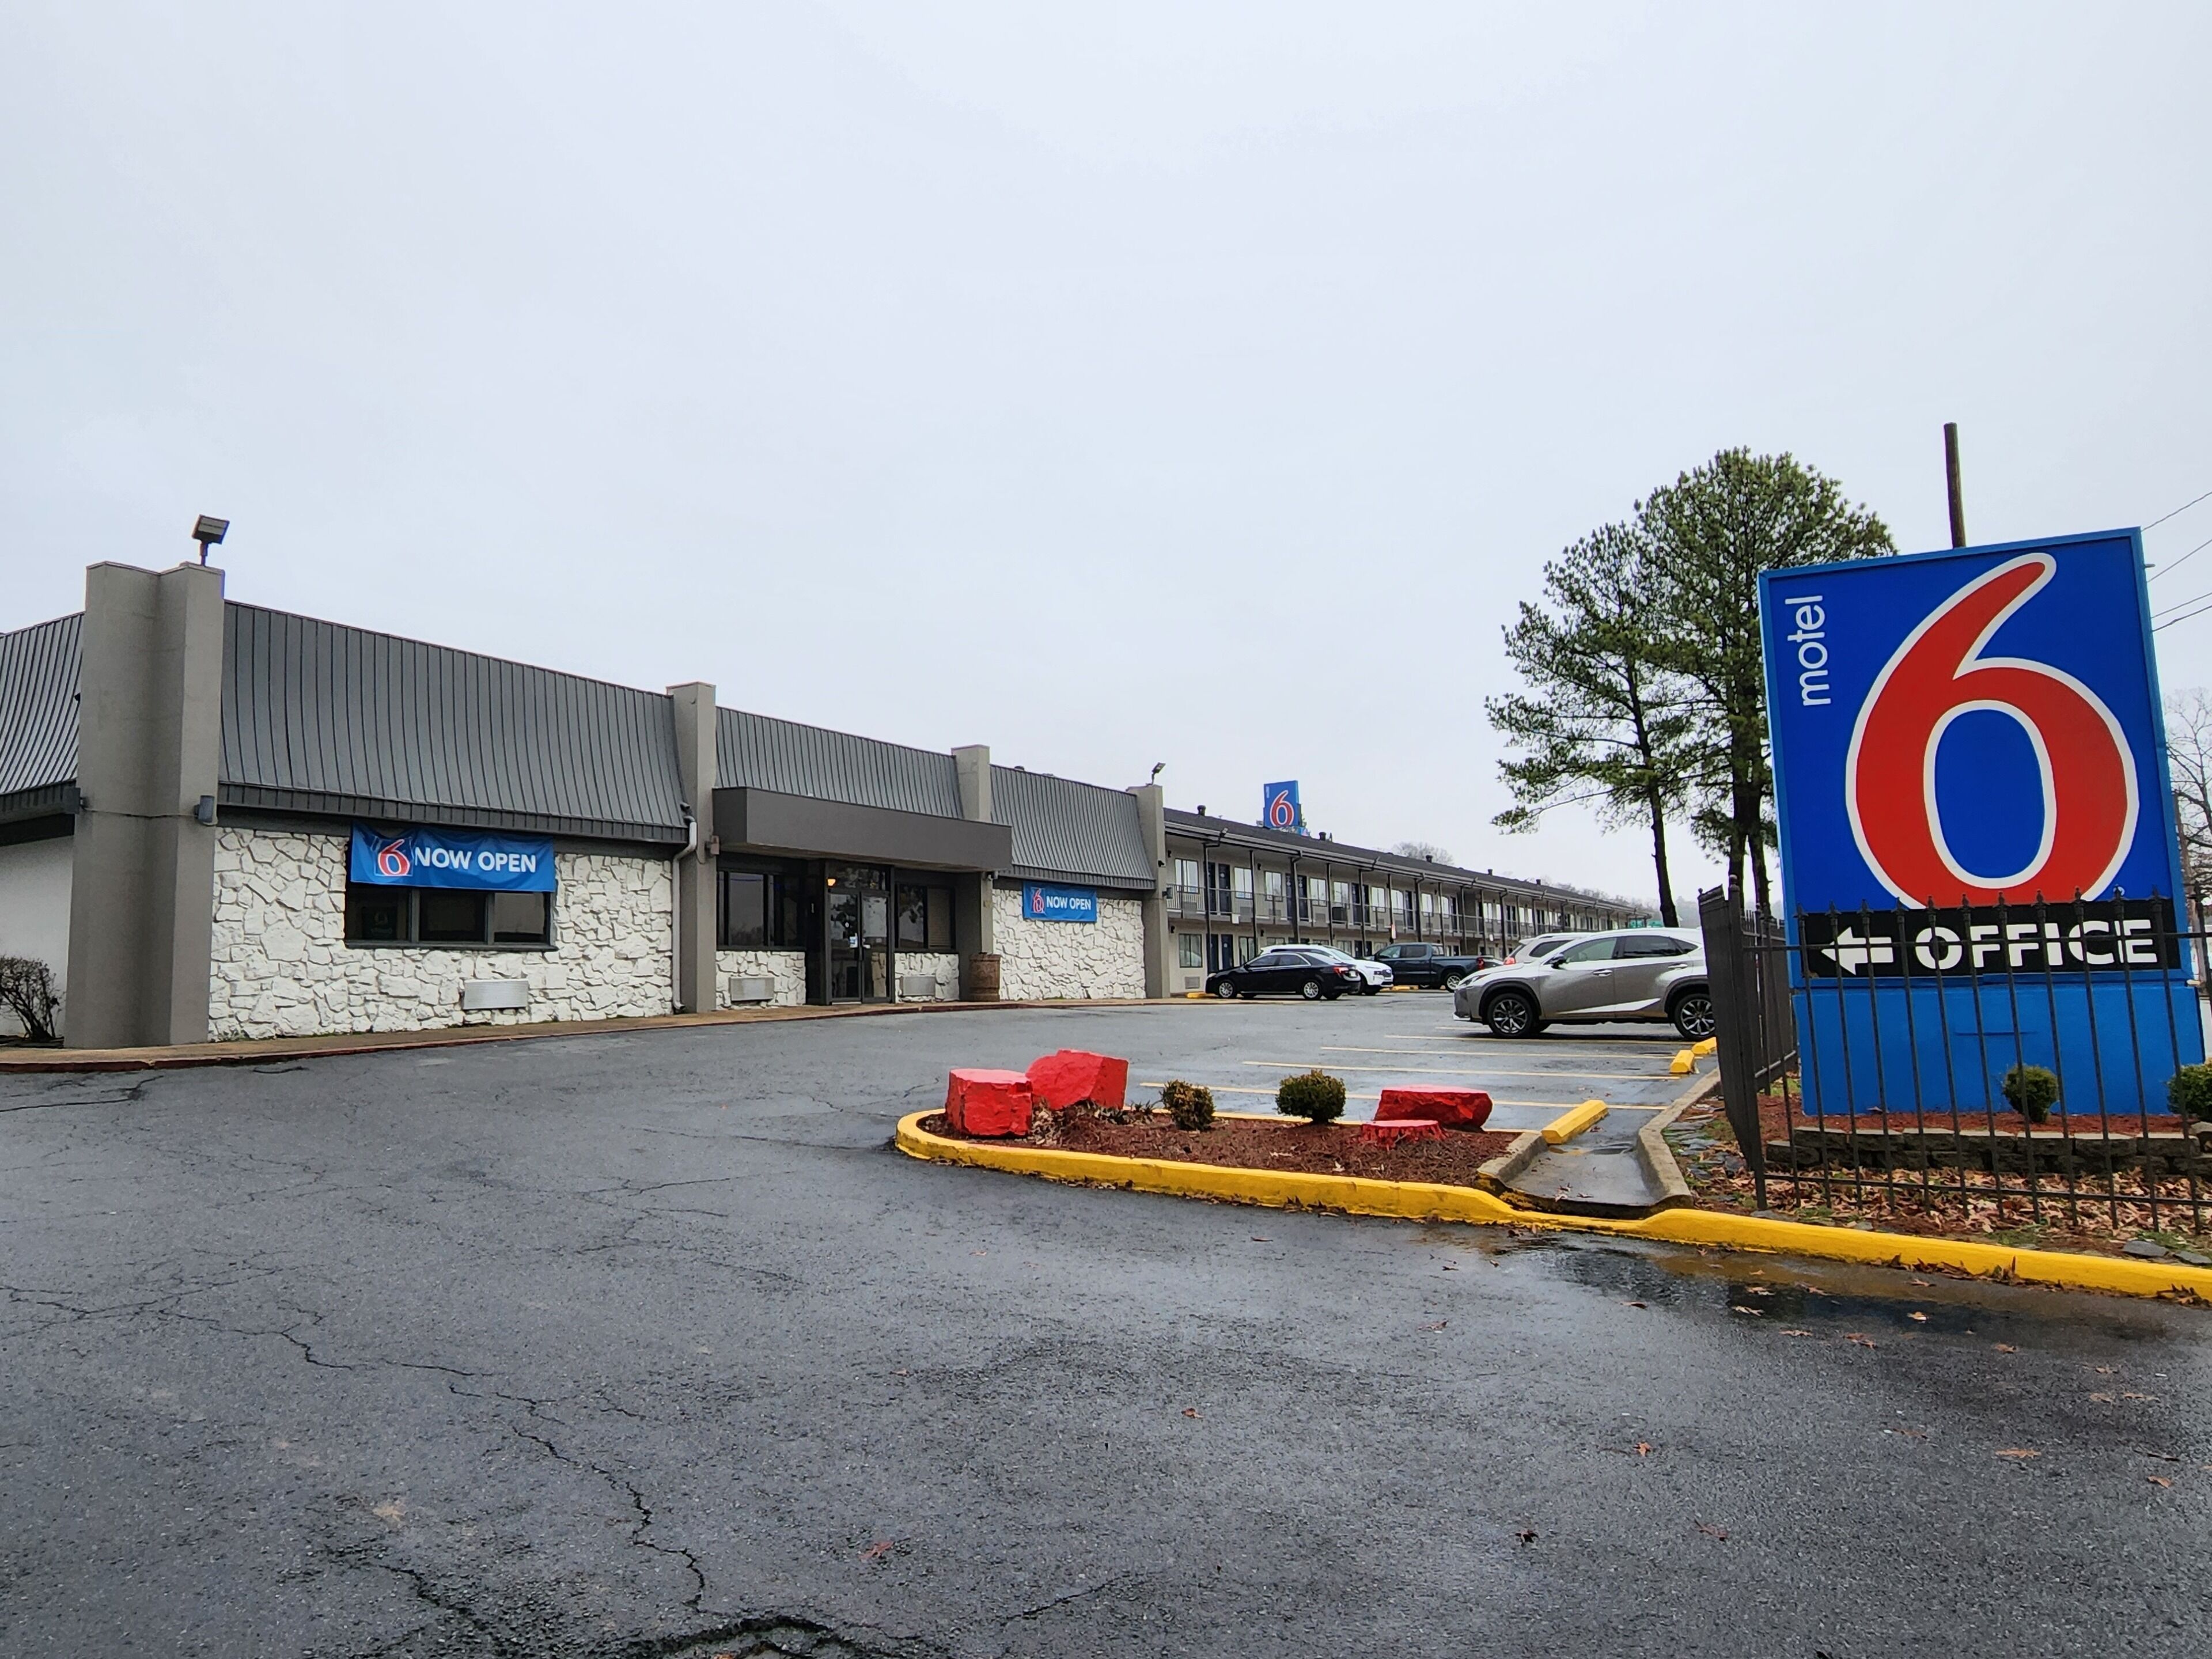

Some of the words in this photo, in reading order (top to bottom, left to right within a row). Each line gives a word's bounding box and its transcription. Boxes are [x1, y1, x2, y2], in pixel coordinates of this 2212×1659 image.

[1785, 595, 1831, 706] motel
[1846, 552, 2139, 909] 6
[1270, 790, 1294, 827] 6
[378, 839, 410, 876] 6
[415, 847, 472, 868] NOW
[478, 851, 536, 873] OPEN
[1033, 888, 1044, 912] 6
[1046, 896, 1068, 909] NOW
[1069, 897, 1092, 910] OPEN
[1915, 919, 2158, 969] OFFICE
